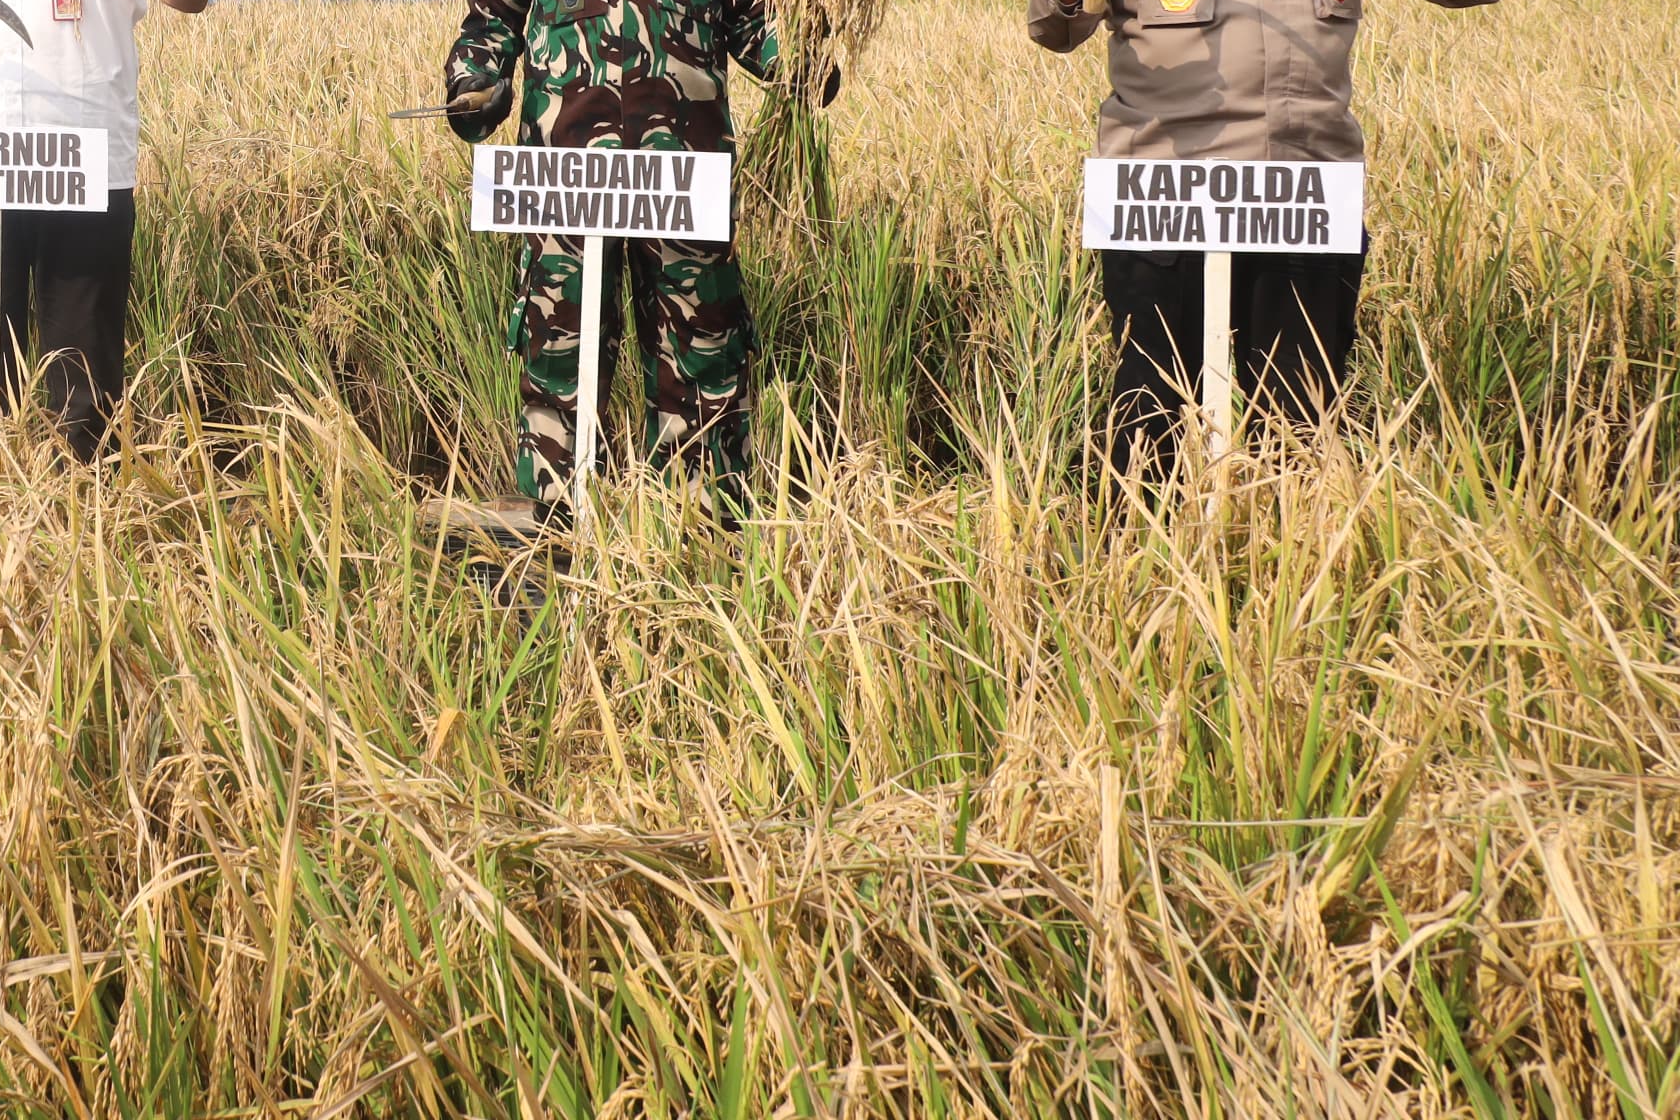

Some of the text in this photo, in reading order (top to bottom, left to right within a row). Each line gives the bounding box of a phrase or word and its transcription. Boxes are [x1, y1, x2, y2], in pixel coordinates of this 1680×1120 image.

[493, 149, 696, 192] PANGDAM V
[1116, 163, 1326, 204] KAPOLDA
[493, 188, 695, 232] BRAWIJAYA
[1110, 203, 1330, 246] JAWA TIMUR
